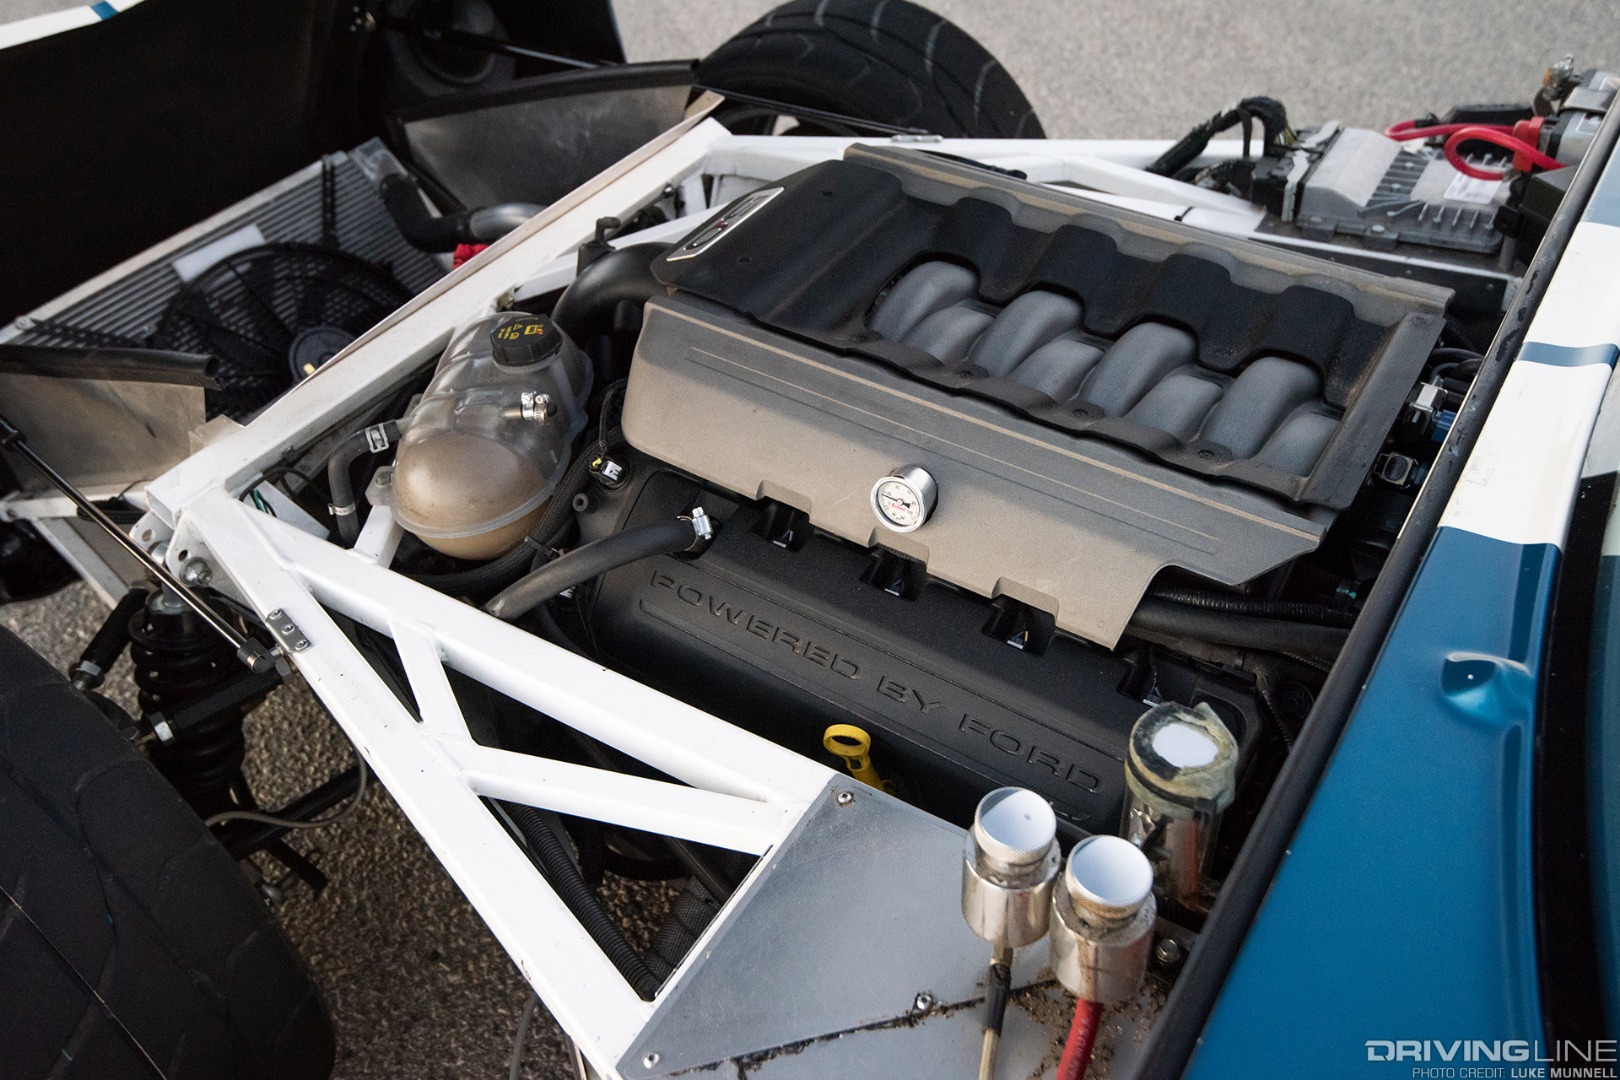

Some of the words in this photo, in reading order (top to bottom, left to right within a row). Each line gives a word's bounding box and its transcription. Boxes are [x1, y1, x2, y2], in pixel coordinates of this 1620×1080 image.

[650, 570, 861, 681] POWERED
[876, 675, 947, 714] BY
[958, 713, 1102, 793] FORD
